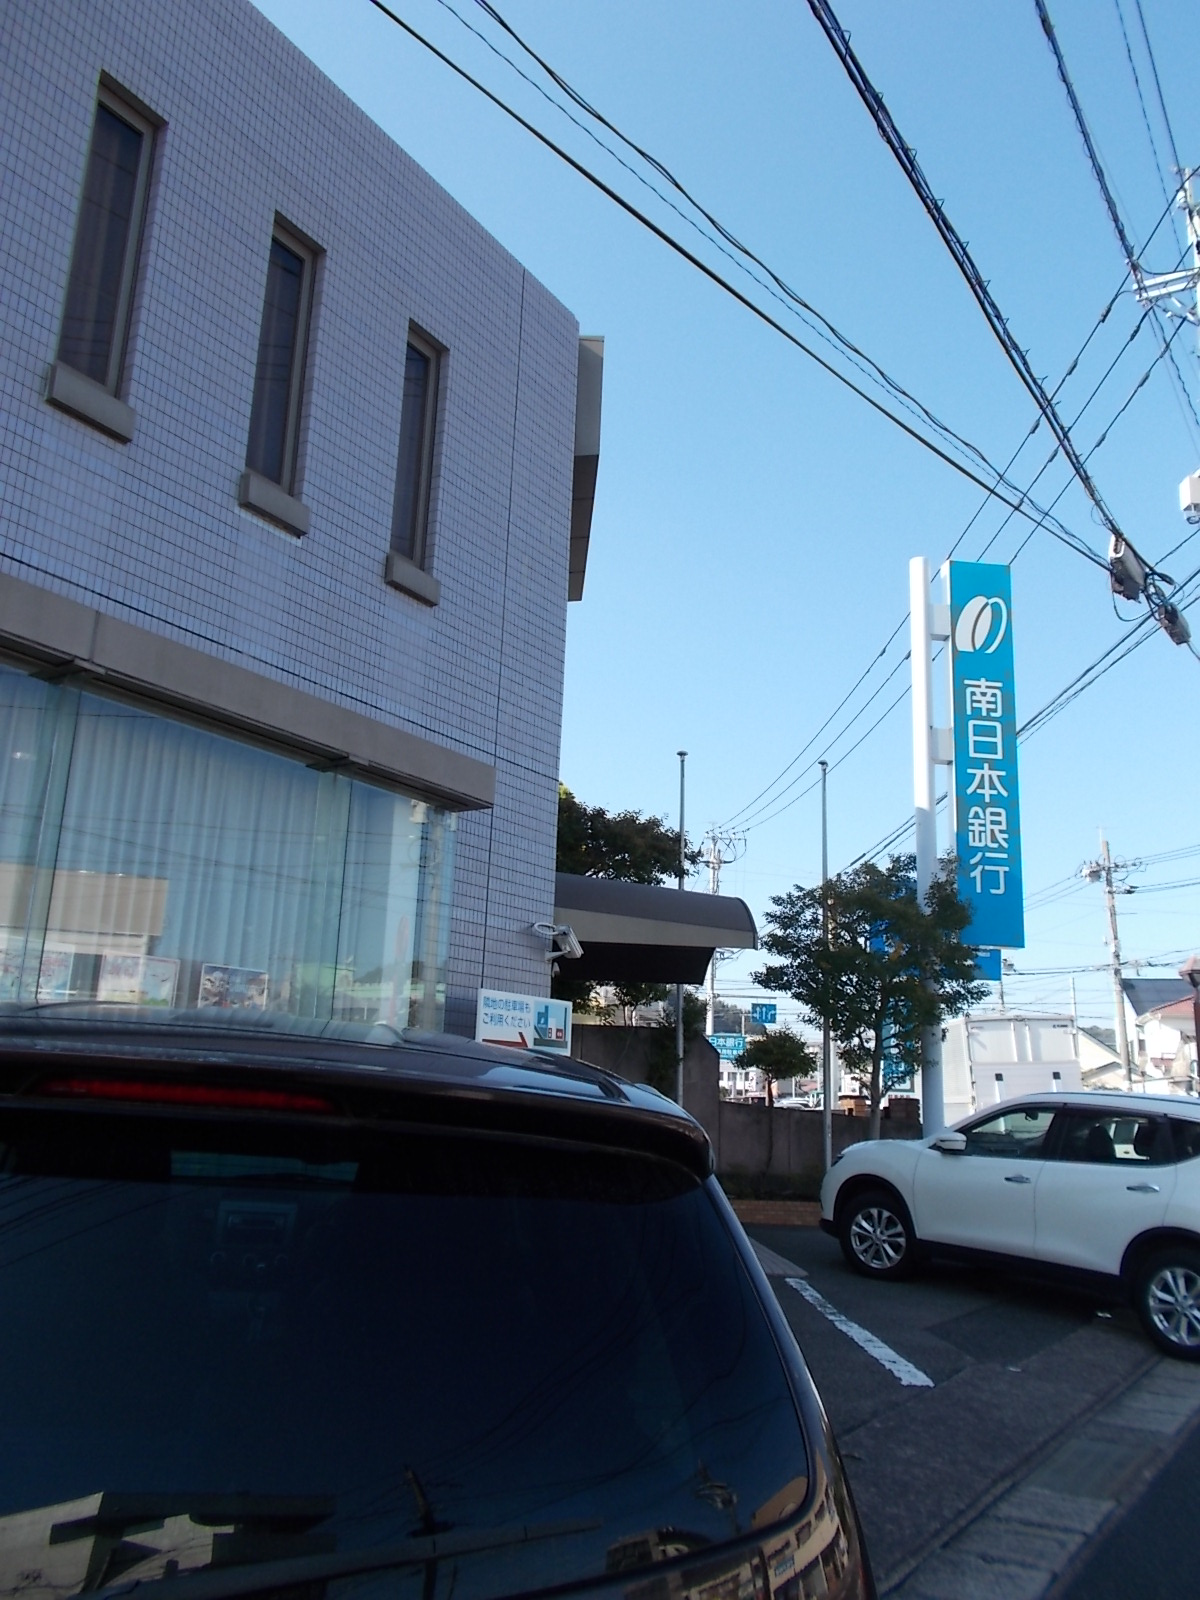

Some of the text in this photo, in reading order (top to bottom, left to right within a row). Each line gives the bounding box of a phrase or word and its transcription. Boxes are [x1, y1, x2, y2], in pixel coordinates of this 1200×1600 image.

[963, 677, 1010, 896] 南日本銀行
[482, 996, 531, 1014] 隣地の駐車場も
[482, 1012, 531, 1028] ご利用ください
